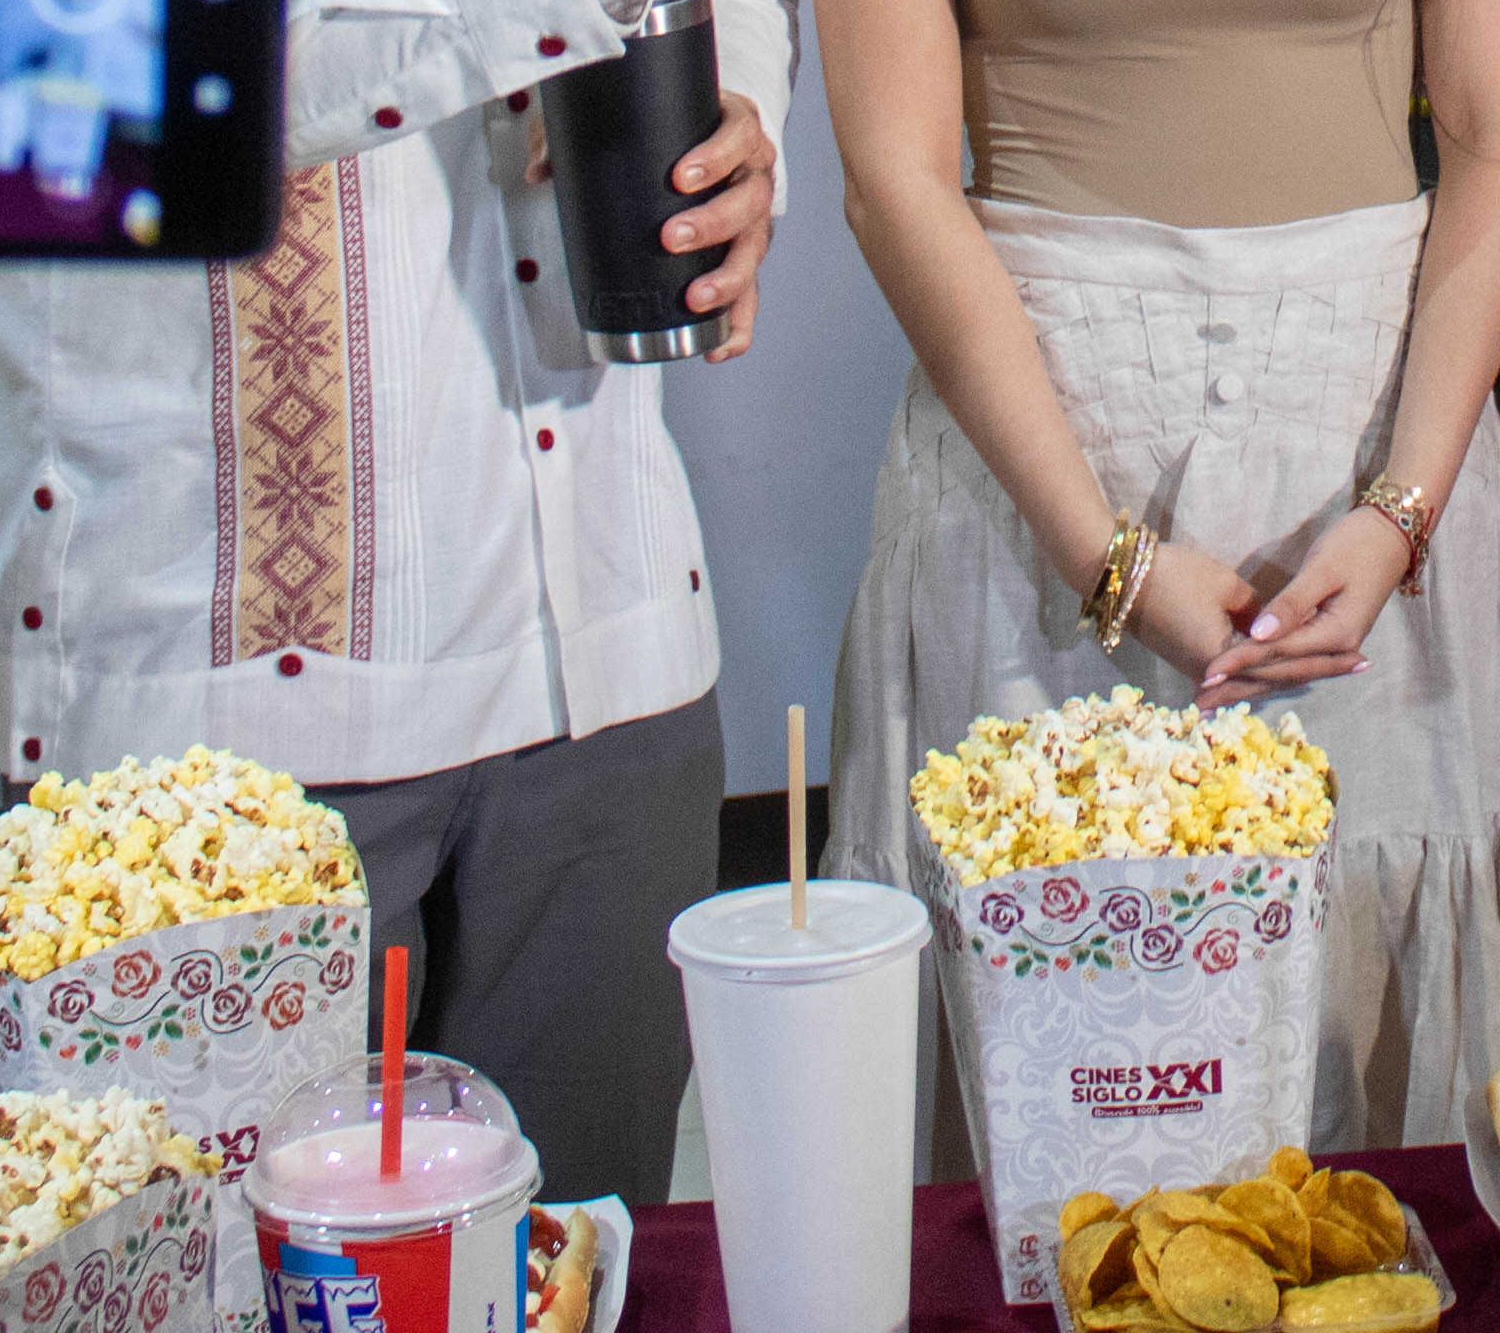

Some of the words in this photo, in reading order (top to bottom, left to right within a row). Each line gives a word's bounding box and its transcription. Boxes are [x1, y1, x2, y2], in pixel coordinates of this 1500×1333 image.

[1070, 1066, 1142, 1085] CINES
[1146, 1058, 1223, 1102] XXI
[1071, 1085, 1143, 1103] SIGLO
